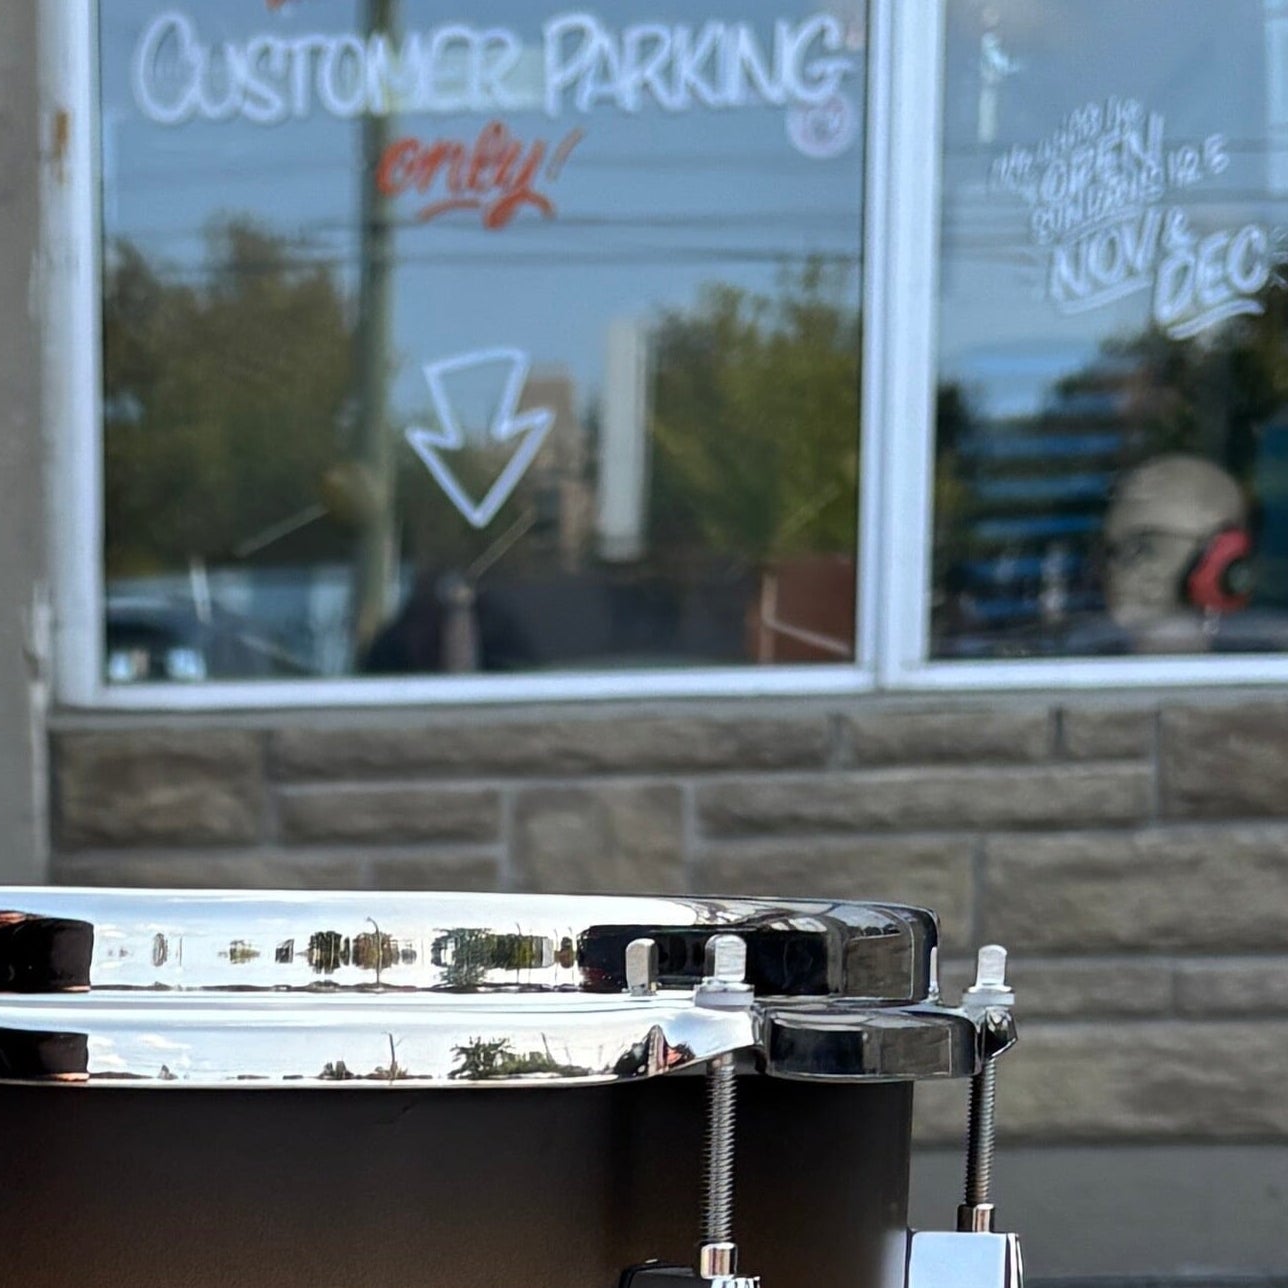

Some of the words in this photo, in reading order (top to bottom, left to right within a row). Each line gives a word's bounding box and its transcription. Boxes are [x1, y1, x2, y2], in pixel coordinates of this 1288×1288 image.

[543, 13, 855, 118] PARKING
[1049, 208, 1162, 301] NOV
[1155, 223, 1270, 325] DEC
